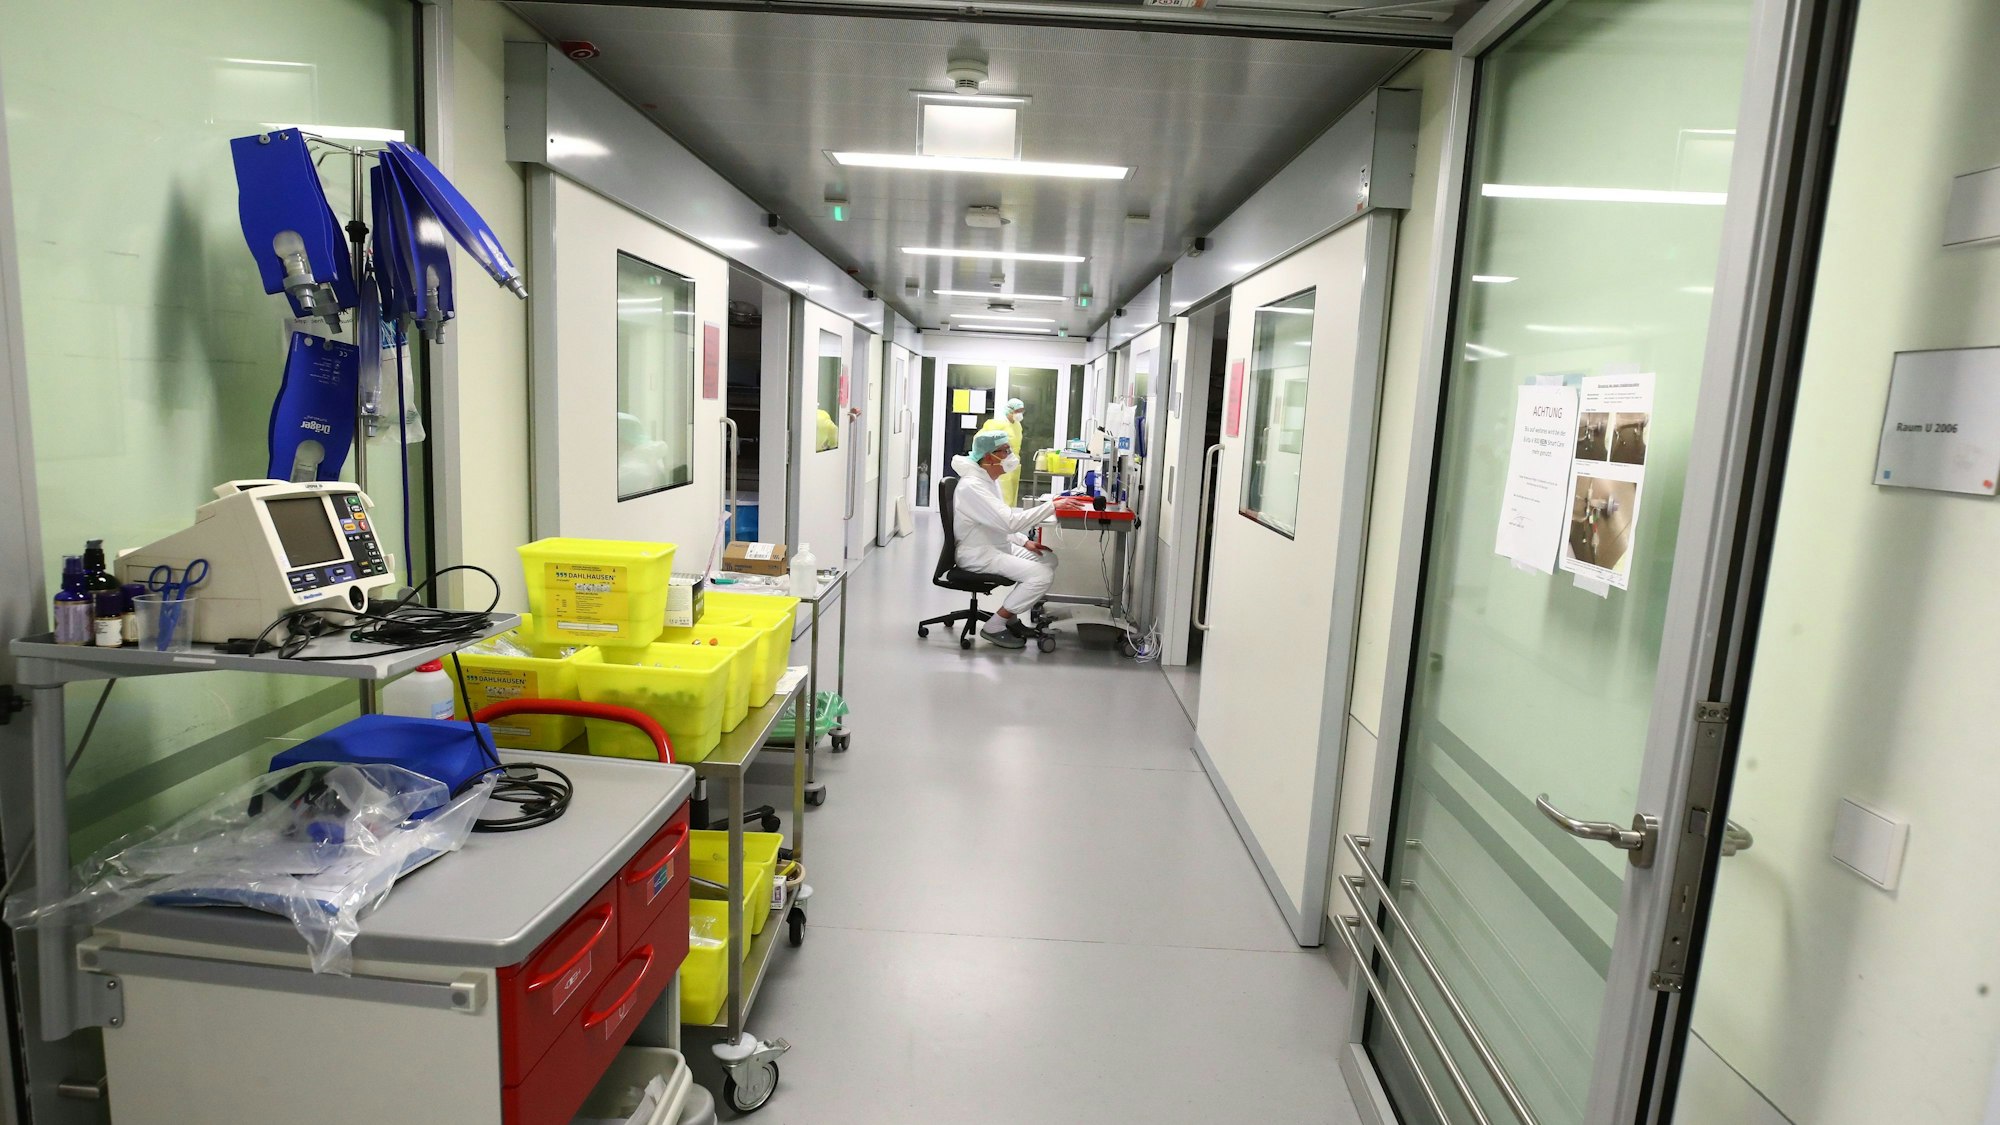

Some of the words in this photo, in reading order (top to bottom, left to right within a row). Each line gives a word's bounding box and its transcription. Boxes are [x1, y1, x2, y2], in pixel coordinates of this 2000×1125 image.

[1533, 406, 1562, 418] ACHTUNG
[300, 420, 331, 435] Dräger
[1896, 422, 1923, 432] Raum
[1925, 423, 1933, 433] U
[1934, 423, 1959, 434] 2006
[568, 572, 614, 581] DAHLHAUSEN
[479, 675, 525, 685] DAHLHAUSEN
